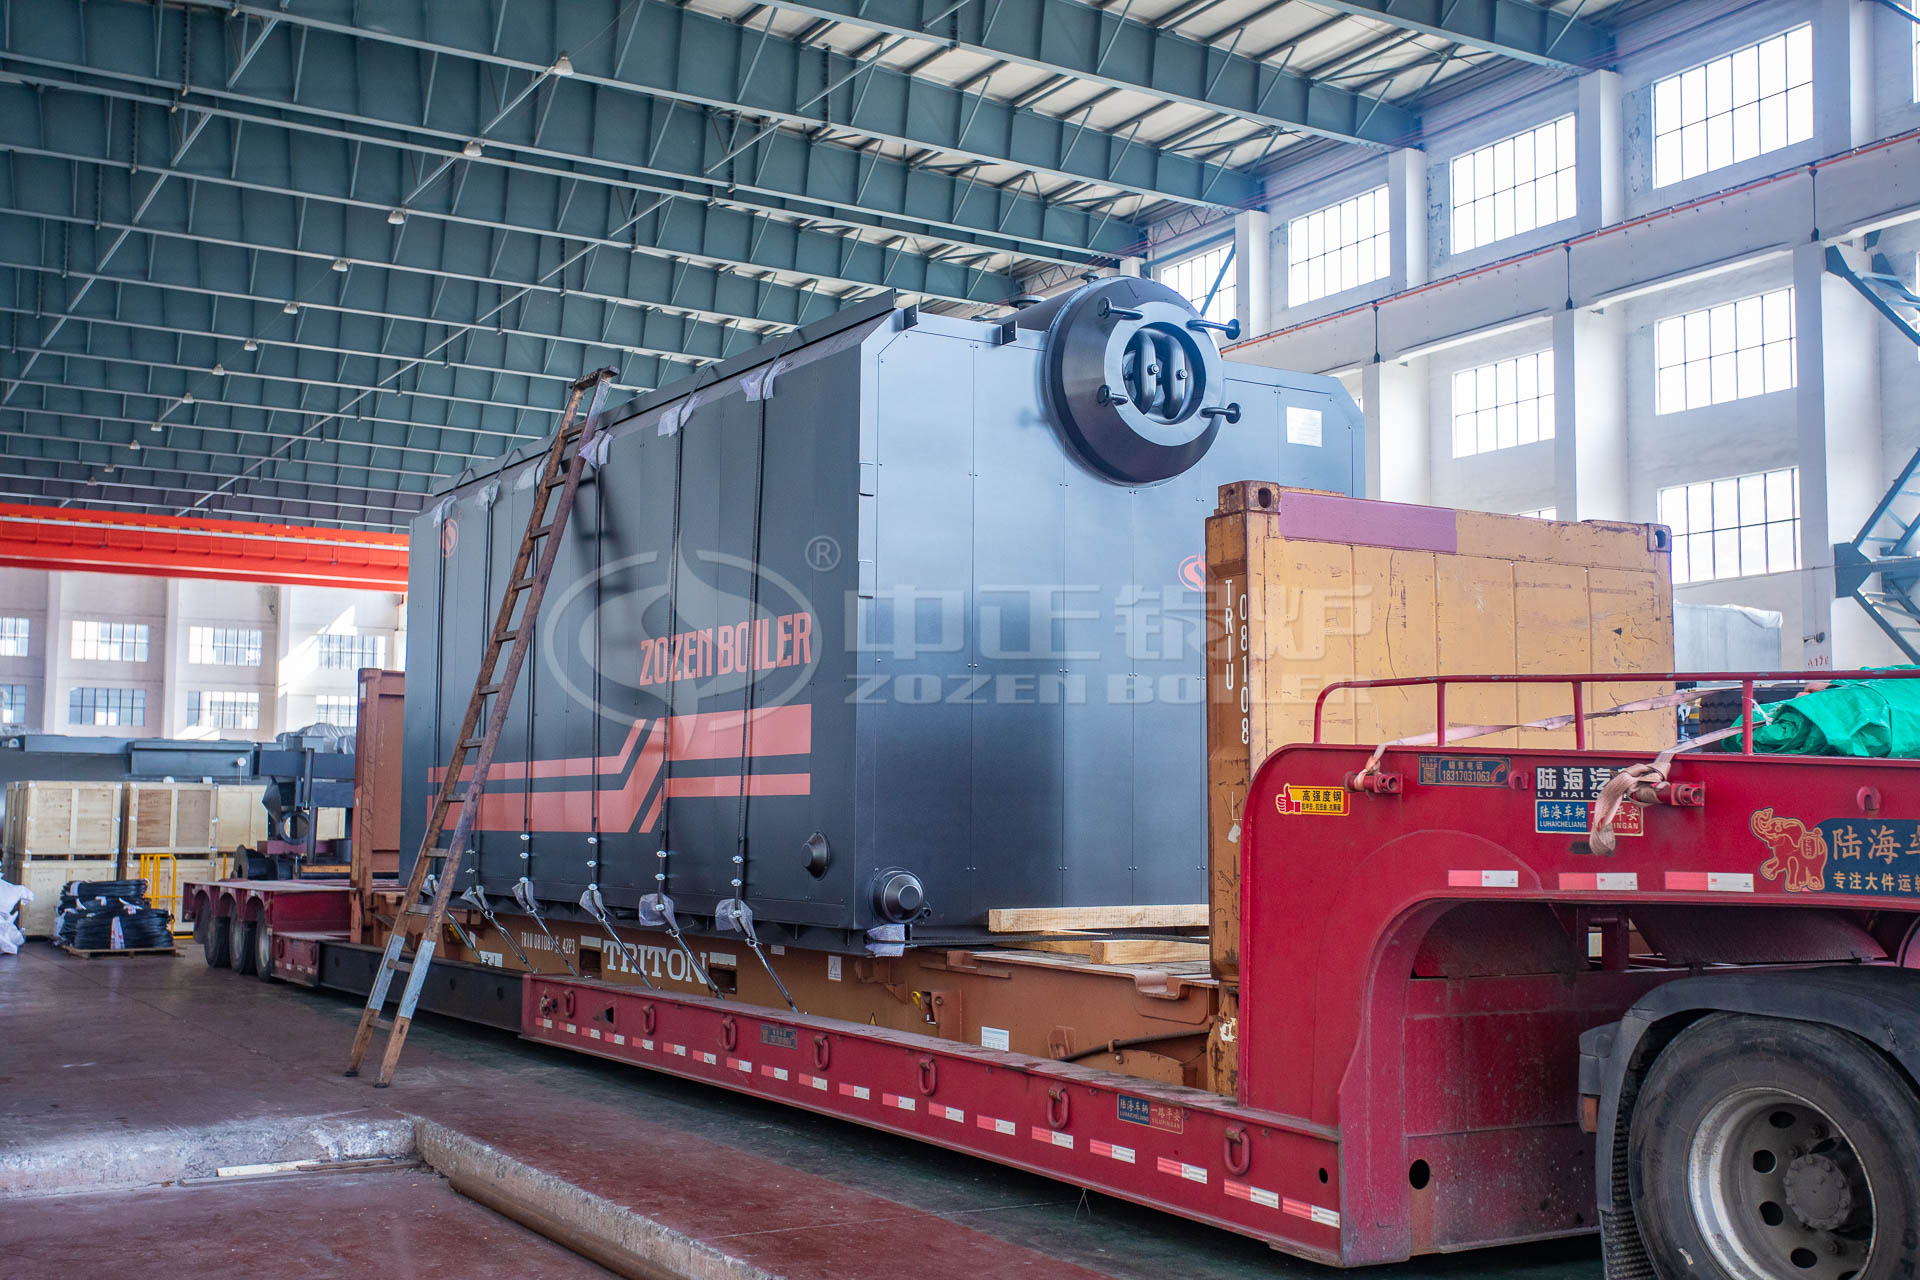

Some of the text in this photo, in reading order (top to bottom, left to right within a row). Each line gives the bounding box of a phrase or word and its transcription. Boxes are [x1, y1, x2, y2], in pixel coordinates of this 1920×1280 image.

[1225, 579, 1234, 690] TRIU
[639, 612, 812, 686] ZOZEN BOILER
[1537, 767, 1627, 790] 陆海汽
[1302, 790, 1342, 802] 高强度钢
[1540, 803, 1587, 820] 陆海车辆
[1540, 820, 1587, 829] LUHAICHELIANG
[603, 939, 708, 985] TRITON
